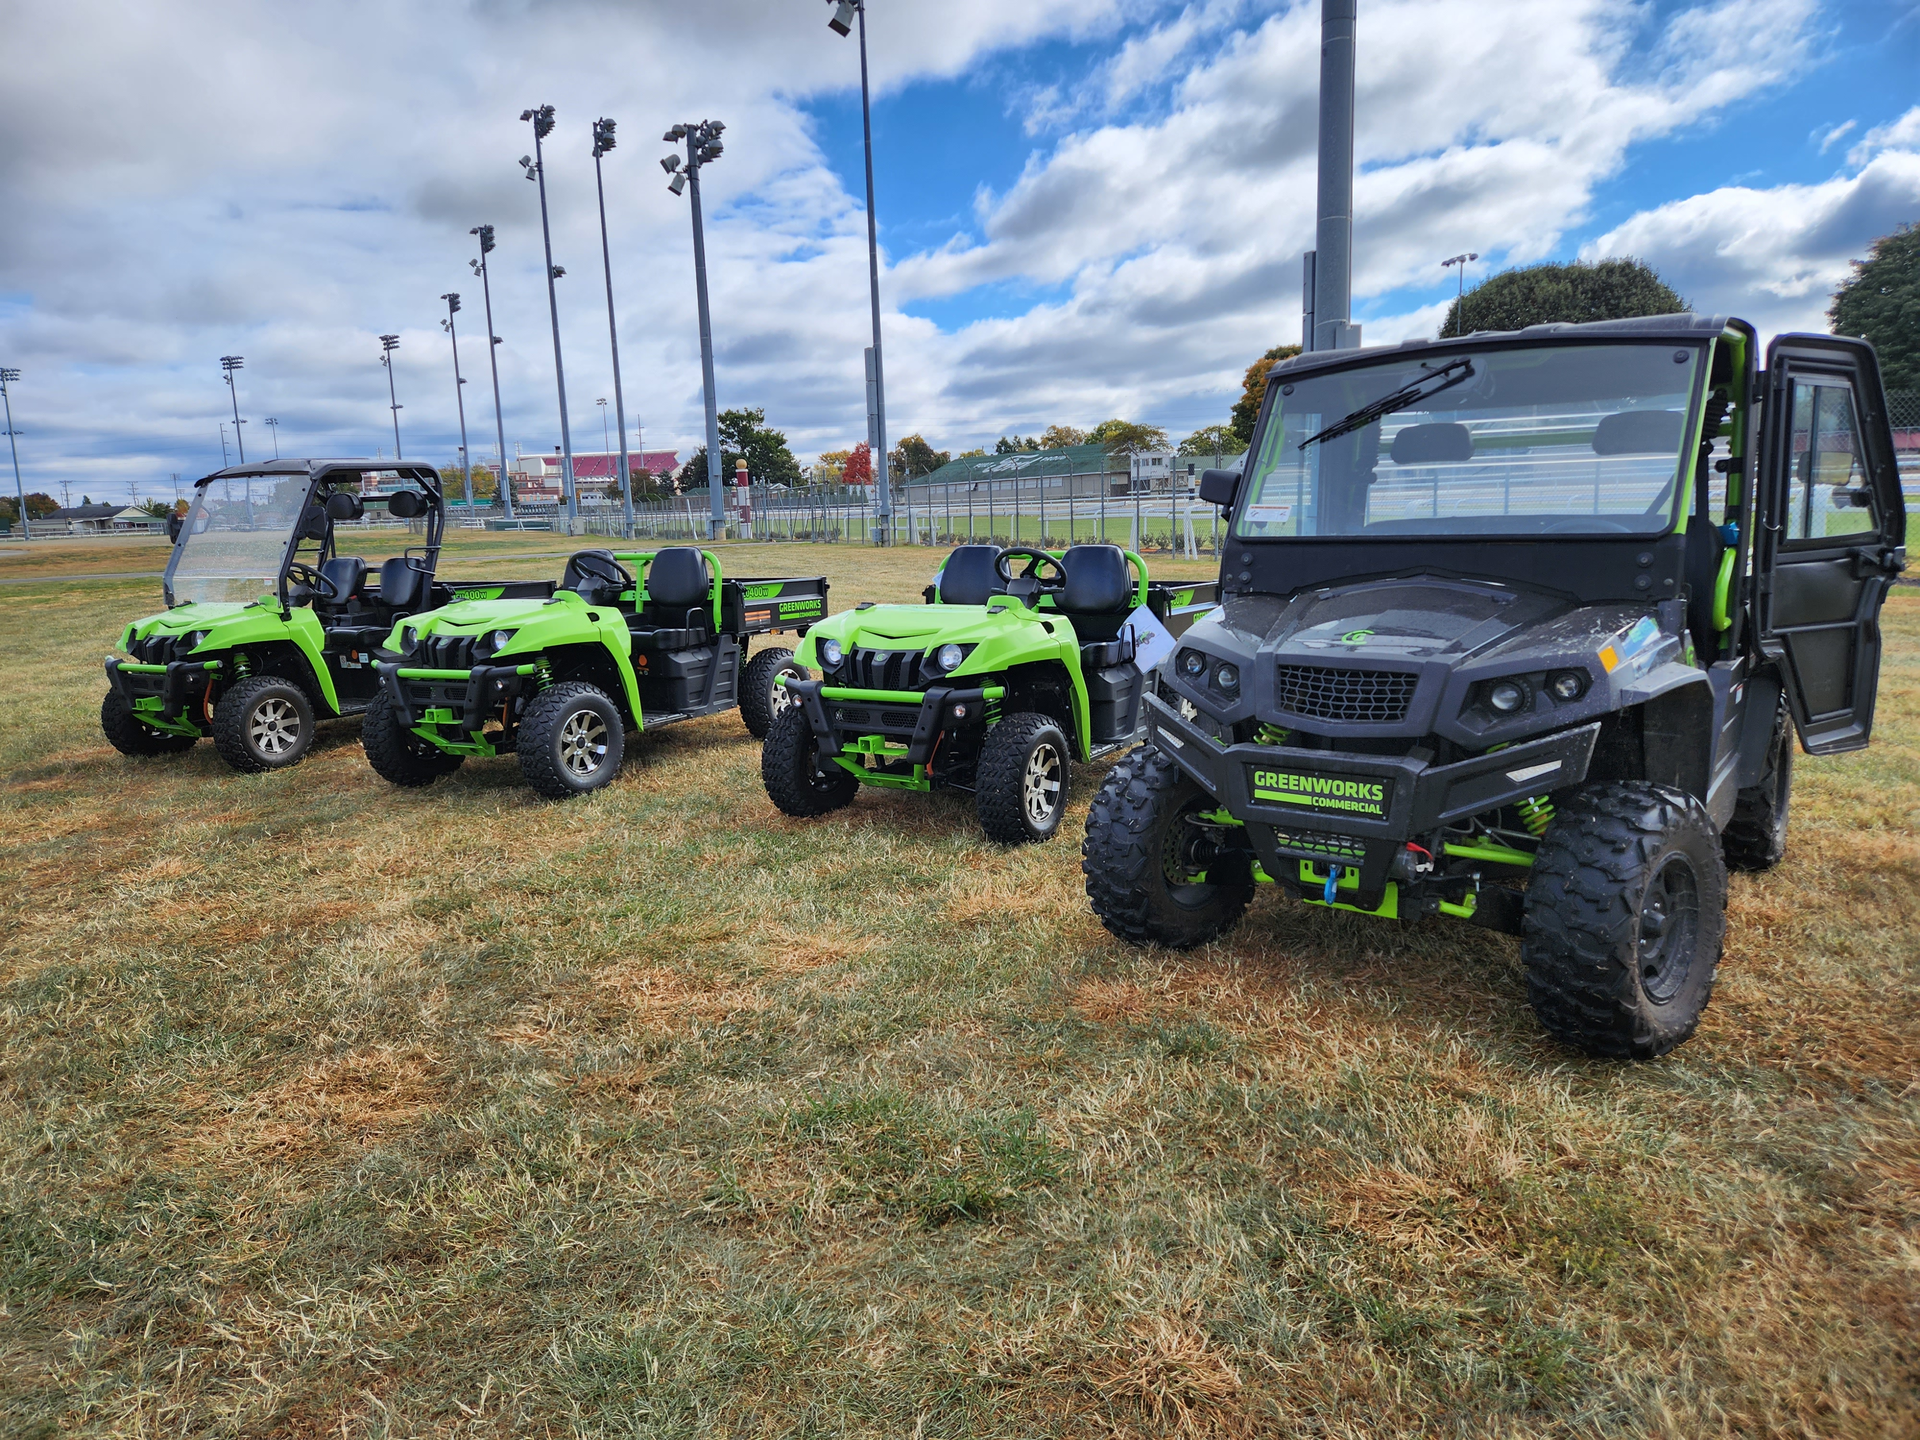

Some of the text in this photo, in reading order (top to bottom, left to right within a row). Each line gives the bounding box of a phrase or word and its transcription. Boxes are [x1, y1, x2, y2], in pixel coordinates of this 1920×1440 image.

[779, 600, 821, 613] GREENWORKS
[1254, 771, 1384, 801] GREENWORKS
[1312, 796, 1383, 815] COMMERCIAL
